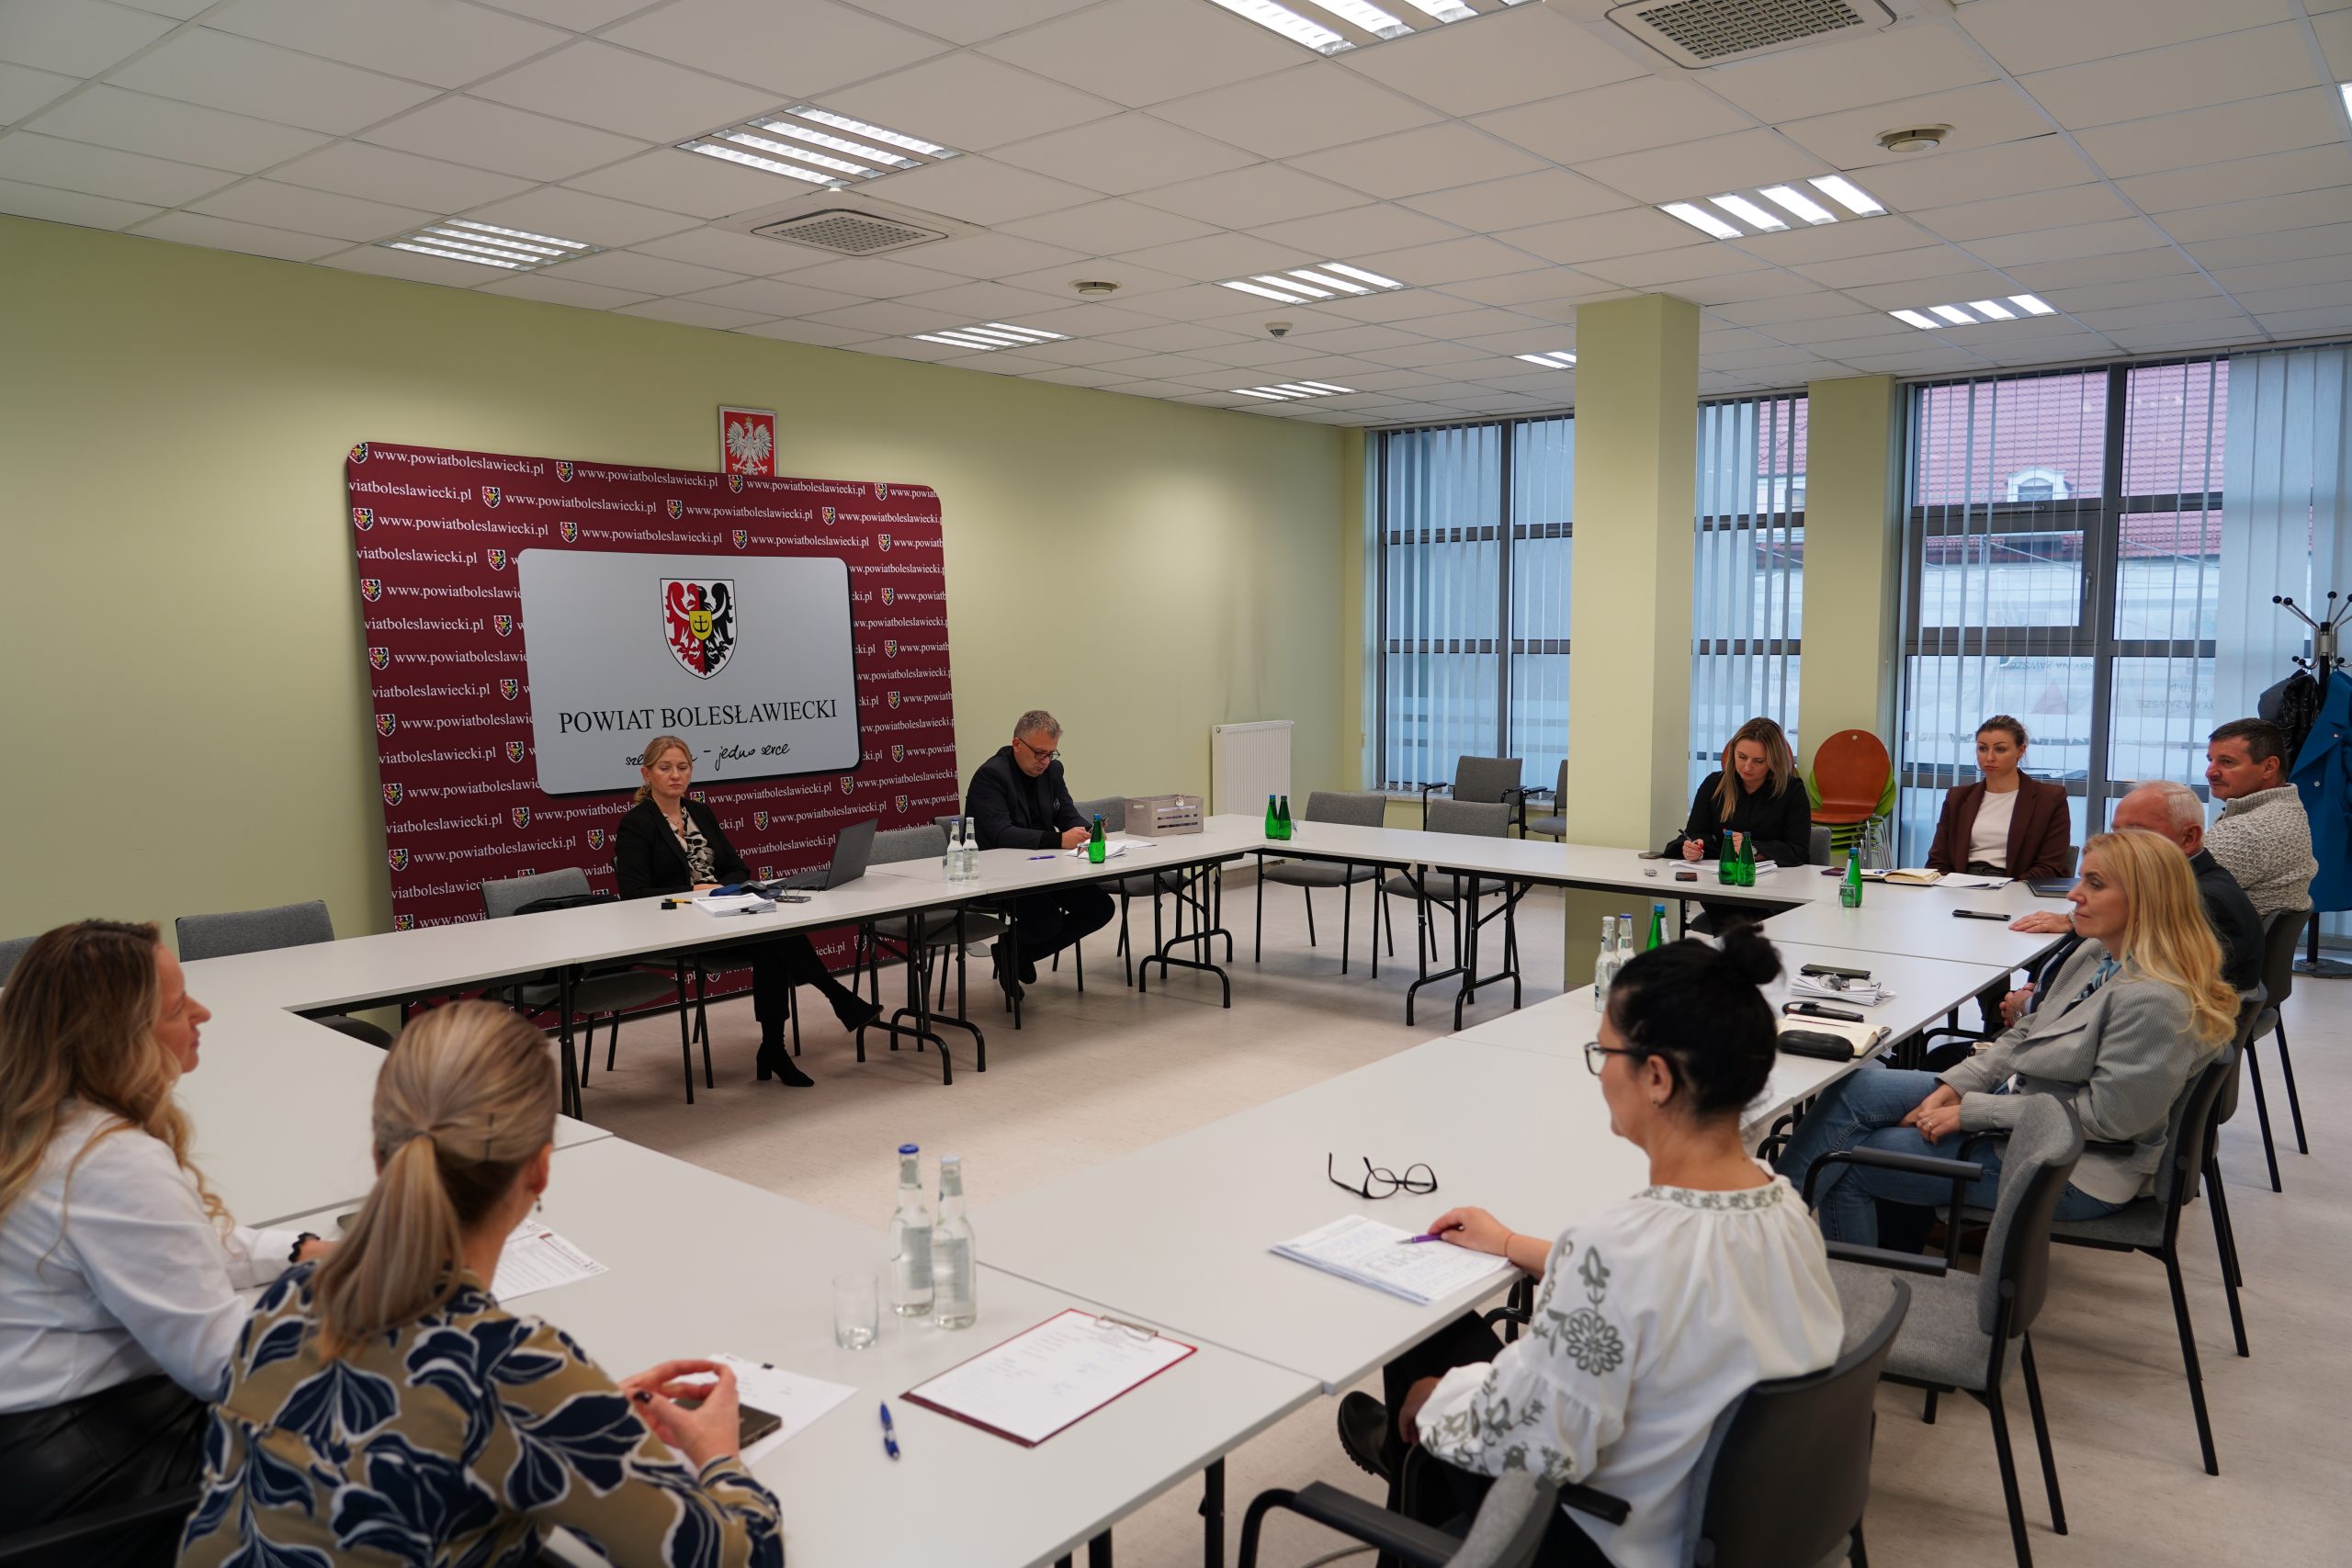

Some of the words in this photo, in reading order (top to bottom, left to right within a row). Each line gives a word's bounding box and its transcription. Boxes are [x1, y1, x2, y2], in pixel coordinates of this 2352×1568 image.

[374, 450, 544, 476] www.powiatboleslawiecki.pl
[578, 469, 718, 489] www.powiatboleslawiecki.pl
[746, 479, 865, 496] www.powiatboleslawiecki.pl
[505, 494, 656, 514] www.powiatboleslawiecki.pl
[686, 506, 813, 522] www.powiatboleslawiecki.pl
[379, 515, 548, 537] www.powiatboleslawiecki.pl
[582, 529, 723, 546] www.powiatboleslawiecki.pl
[751, 535, 869, 550] www.powiatboleslawiecki.pl
[559, 709, 655, 734] POWIAT
[661, 699, 838, 728] BOLESŁAWIECKI
[715, 745, 756, 771] jedno
[761, 743, 791, 756] serce
[708, 782, 831, 804] www.powiatboleslawiecki.pl
[772, 801, 887, 823] www.powiatboleslawiecki.pl
[413, 835, 576, 863] www.powiatboleslawiecki.pl
